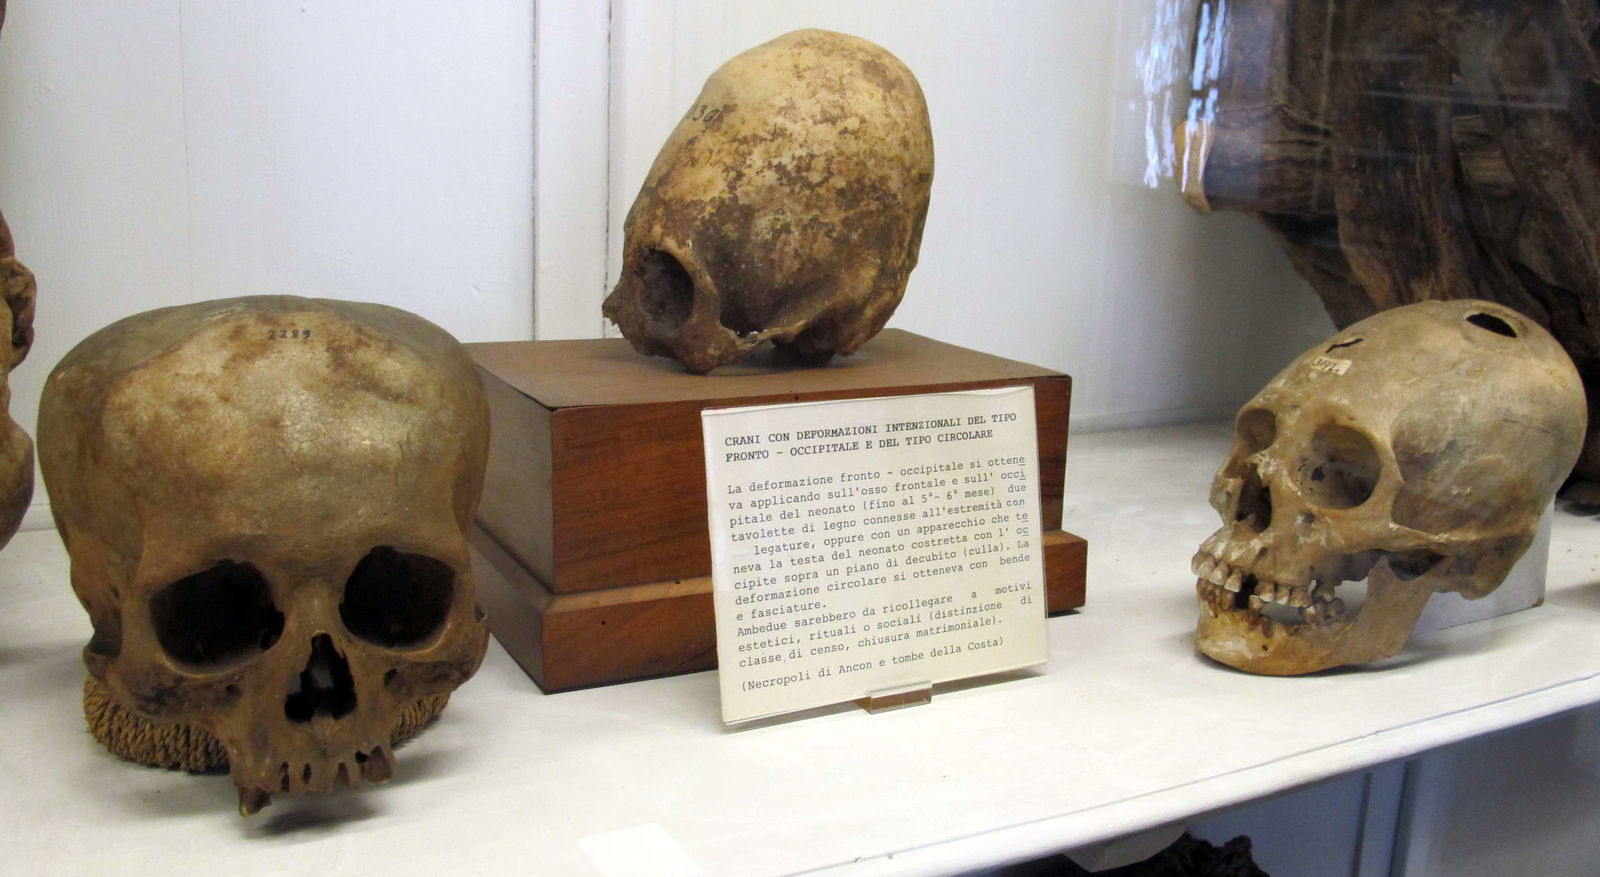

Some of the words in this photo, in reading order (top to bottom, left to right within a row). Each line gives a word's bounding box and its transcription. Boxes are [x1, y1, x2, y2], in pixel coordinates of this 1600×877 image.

[724, 434, 761, 447] CRANI
[767, 432, 790, 443] CON
[796, 424, 878, 441] DEFORMAZIONI
[885, 417, 962, 433] INTENZIONALI
[967, 415, 987, 426] DEL
[991, 412, 1017, 423] TIPO
[725, 449, 770, 463] FRONTO
[789, 441, 860, 457] OCCIPITALE
[865, 440, 873, 450] E
[878, 438, 900, 449] DEL
[905, 434, 932, 446] TIPO
[937, 429, 993, 443] CIRCOLARE
[727, 485, 742, 495] La
[749, 475, 833, 492] deformazione
[840, 471, 881, 483] fronto
[899, 461, 964, 477] occipitale
[969, 458, 982, 469] si
[987, 456, 1025, 467] ottene
[728, 501, 743, 510] va
[750, 491, 821, 510] applicando
[827, 486, 888, 499] sull'osso
[895, 477, 946, 492] frontale
[951, 478, 958, 486] e
[1000, 468, 1026, 480] occi
[729, 512, 773, 529] pitale
[779, 508, 801, 520] del
[807, 504, 856, 517] neonato
[863, 499, 896, 511] (fino
[902, 495, 915, 506] al
[964, 486, 994, 499] mese)
[1007, 483, 1026, 493] due
[731, 527, 795, 542] tavolette
[801, 522, 816, 534] di
[823, 519, 857, 532] legno
[863, 512, 916, 526] connesse
[922, 499, 1003, 519] all'estremità
[1006, 499, 1025, 507] con
[733, 563, 762, 575] neva
[769, 559, 783, 569] la
[790, 554, 825, 566] testa
[831, 548, 852, 561] del
[858, 543, 905, 557] neonato
[911, 535, 968, 550] costretta
[973, 531, 993, 541] con
[1016, 527, 1029, 535] oc
[754, 541, 815, 556] legature,
[823, 534, 865, 548] oppure
[870, 530, 891, 540] con
[896, 528, 911, 537] un
[916, 516, 986, 536] apparecchio
[991, 514, 1009, 524] che
[1016, 512, 1028, 521] te
[734, 576, 777, 591] cipite
[784, 571, 819, 584] sopra
[825, 568, 840, 577] un
[846, 562, 880, 577] piano
[885, 557, 899, 568] di
[905, 551, 957, 565] decubito
[963, 542, 1010, 557] (culla).
[1017, 540, 1030, 549] La
[735, 586, 820, 606] deformazione
[826, 576, 887, 592] circolare
[893, 571, 906, 582] si
[912, 564, 964, 579] otteneva
[969, 561, 988, 570] con
[999, 553, 1030, 565] bende
[736, 613, 744, 621] e
[751, 601, 826, 619] fasciature.
[737, 622, 787, 637] Ambedue
[794, 611, 856, 628] sarebbero
[862, 607, 876, 617] da
[882, 595, 953, 614] ricollegare
[971, 591, 977, 599] a
[995, 581, 1032, 595] motivi
[738, 634, 801, 653] estetici,
[809, 624, 857, 641] rituali
[863, 624, 871, 632] o
[877, 613, 922, 630] sociali
[929, 601, 1003, 621] (distinzione
[1020, 595, 1033, 605] di
[789, 645, 803, 660] di
[809, 642, 851, 657] censo,
[857, 632, 911, 649] chiusura
[915, 615, 1003, 639] matrimoniale).
[742, 671, 811, 692] (Necropoli
[818, 666, 832, 678] di
[838, 661, 873, 674] Ancon
[879, 659, 886, 667] e
[892, 652, 924, 665] tombe
[930, 644, 962, 658] della
[967, 636, 1003, 651] Costa)
